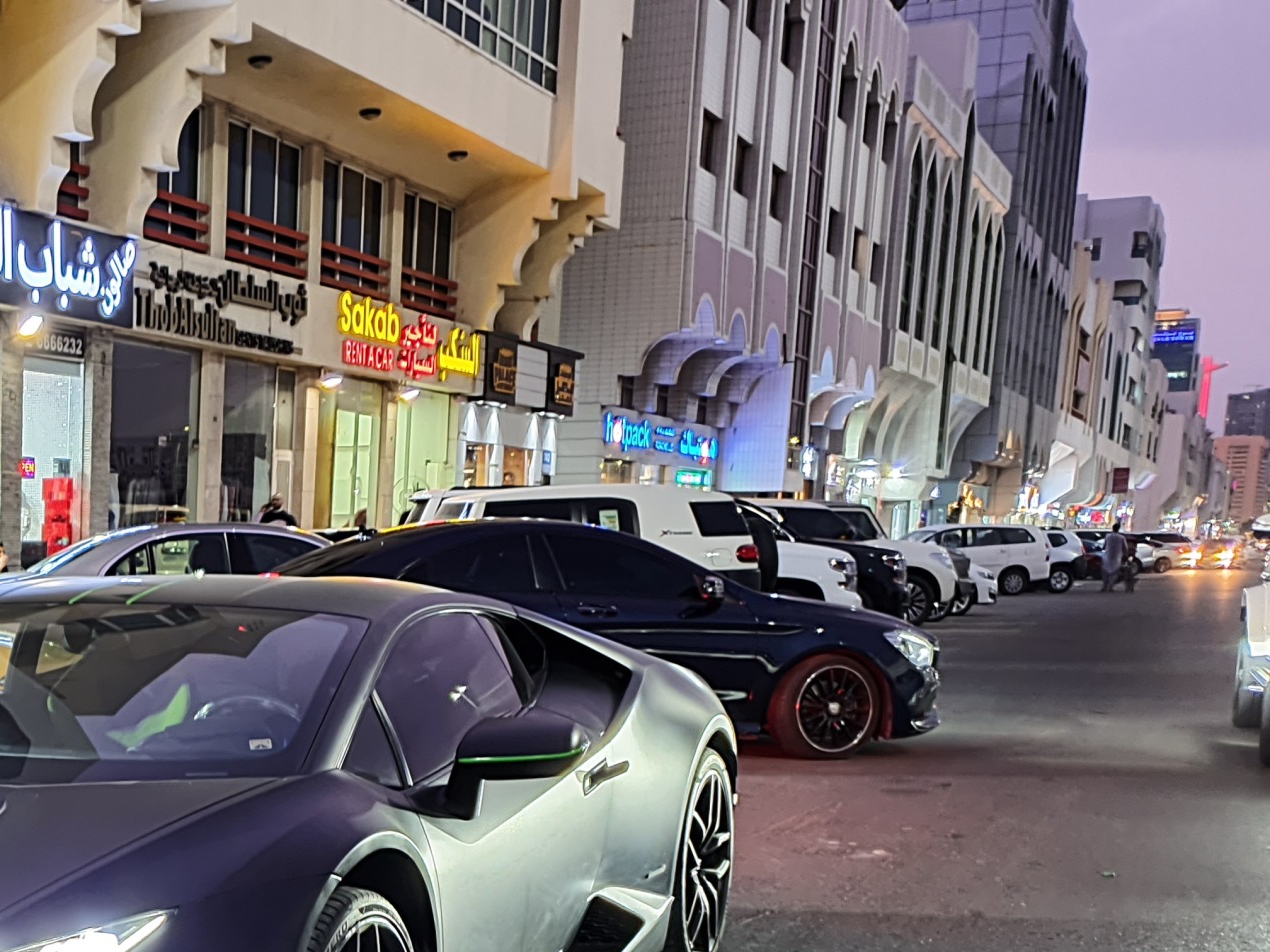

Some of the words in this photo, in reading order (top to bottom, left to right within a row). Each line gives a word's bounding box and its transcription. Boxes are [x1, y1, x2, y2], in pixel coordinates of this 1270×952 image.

[18, 220, 100, 309] شباب
[99, 240, 136, 316] صالون
[338, 290, 401, 344] Sakab
[398, 313, 439, 349] لتأجير
[345, 340, 367, 366] RENT
[367, 345, 374, 367] A
[375, 346, 394, 371] CAR
[397, 348, 438, 381] السيارات
[604, 412, 651, 452] hotpack
